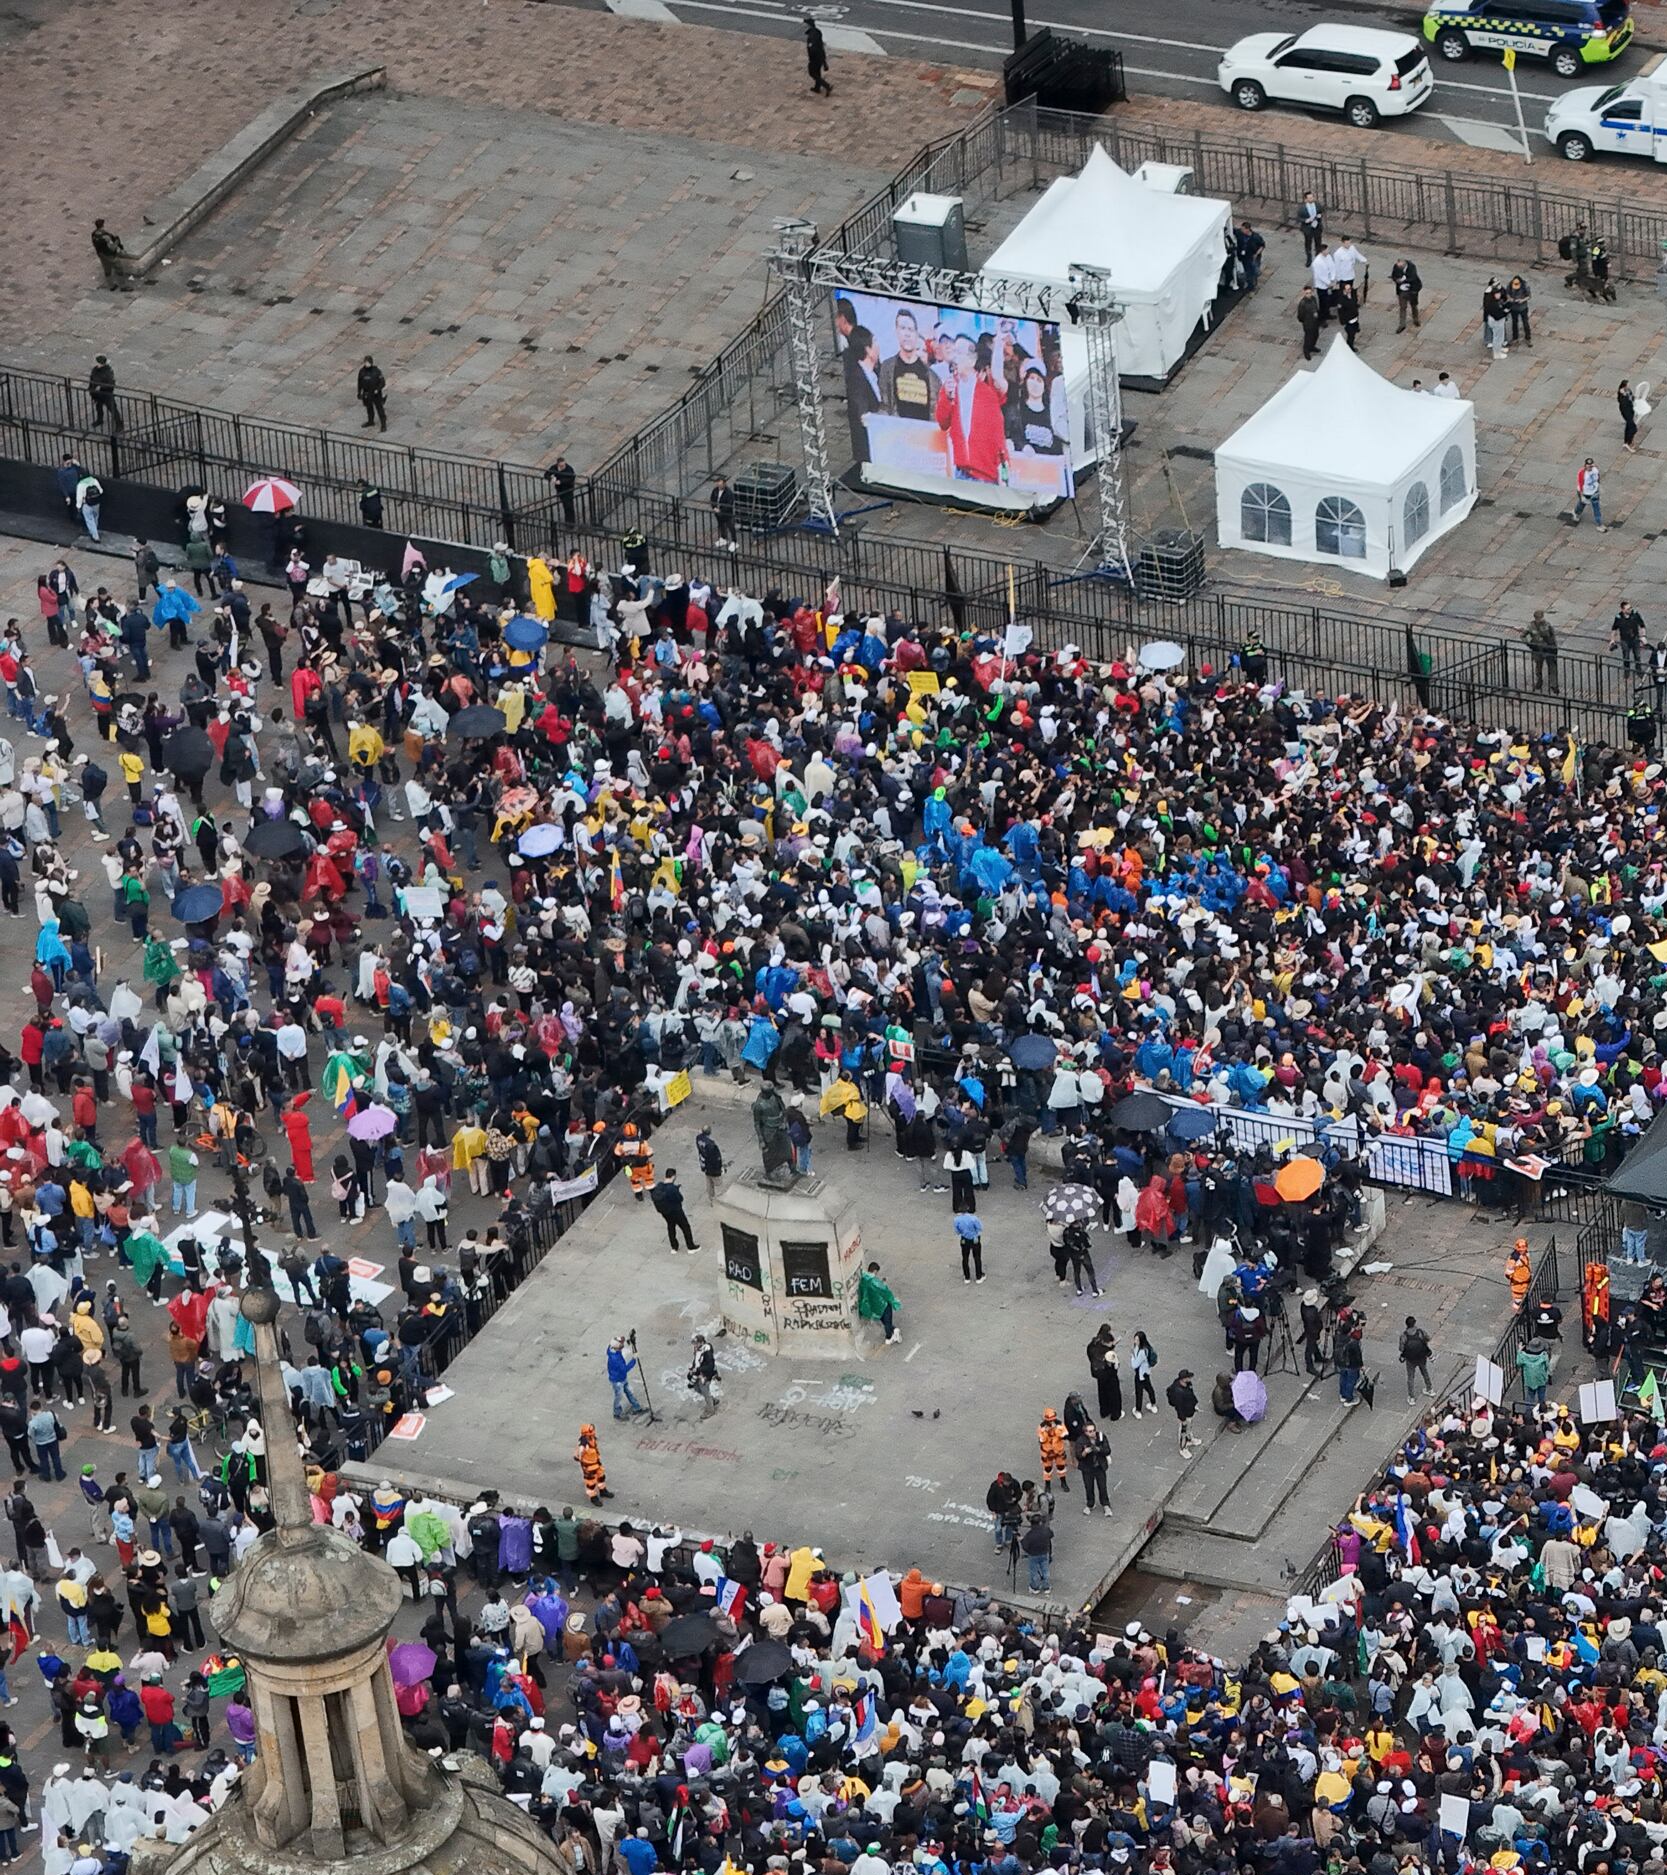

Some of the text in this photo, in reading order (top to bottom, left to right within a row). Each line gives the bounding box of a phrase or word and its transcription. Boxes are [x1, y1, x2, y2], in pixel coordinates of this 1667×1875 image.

[1488, 36, 1536, 50] POLICÍA
[728, 1260, 752, 1281] RAD
[790, 1276, 823, 1294] FEM
